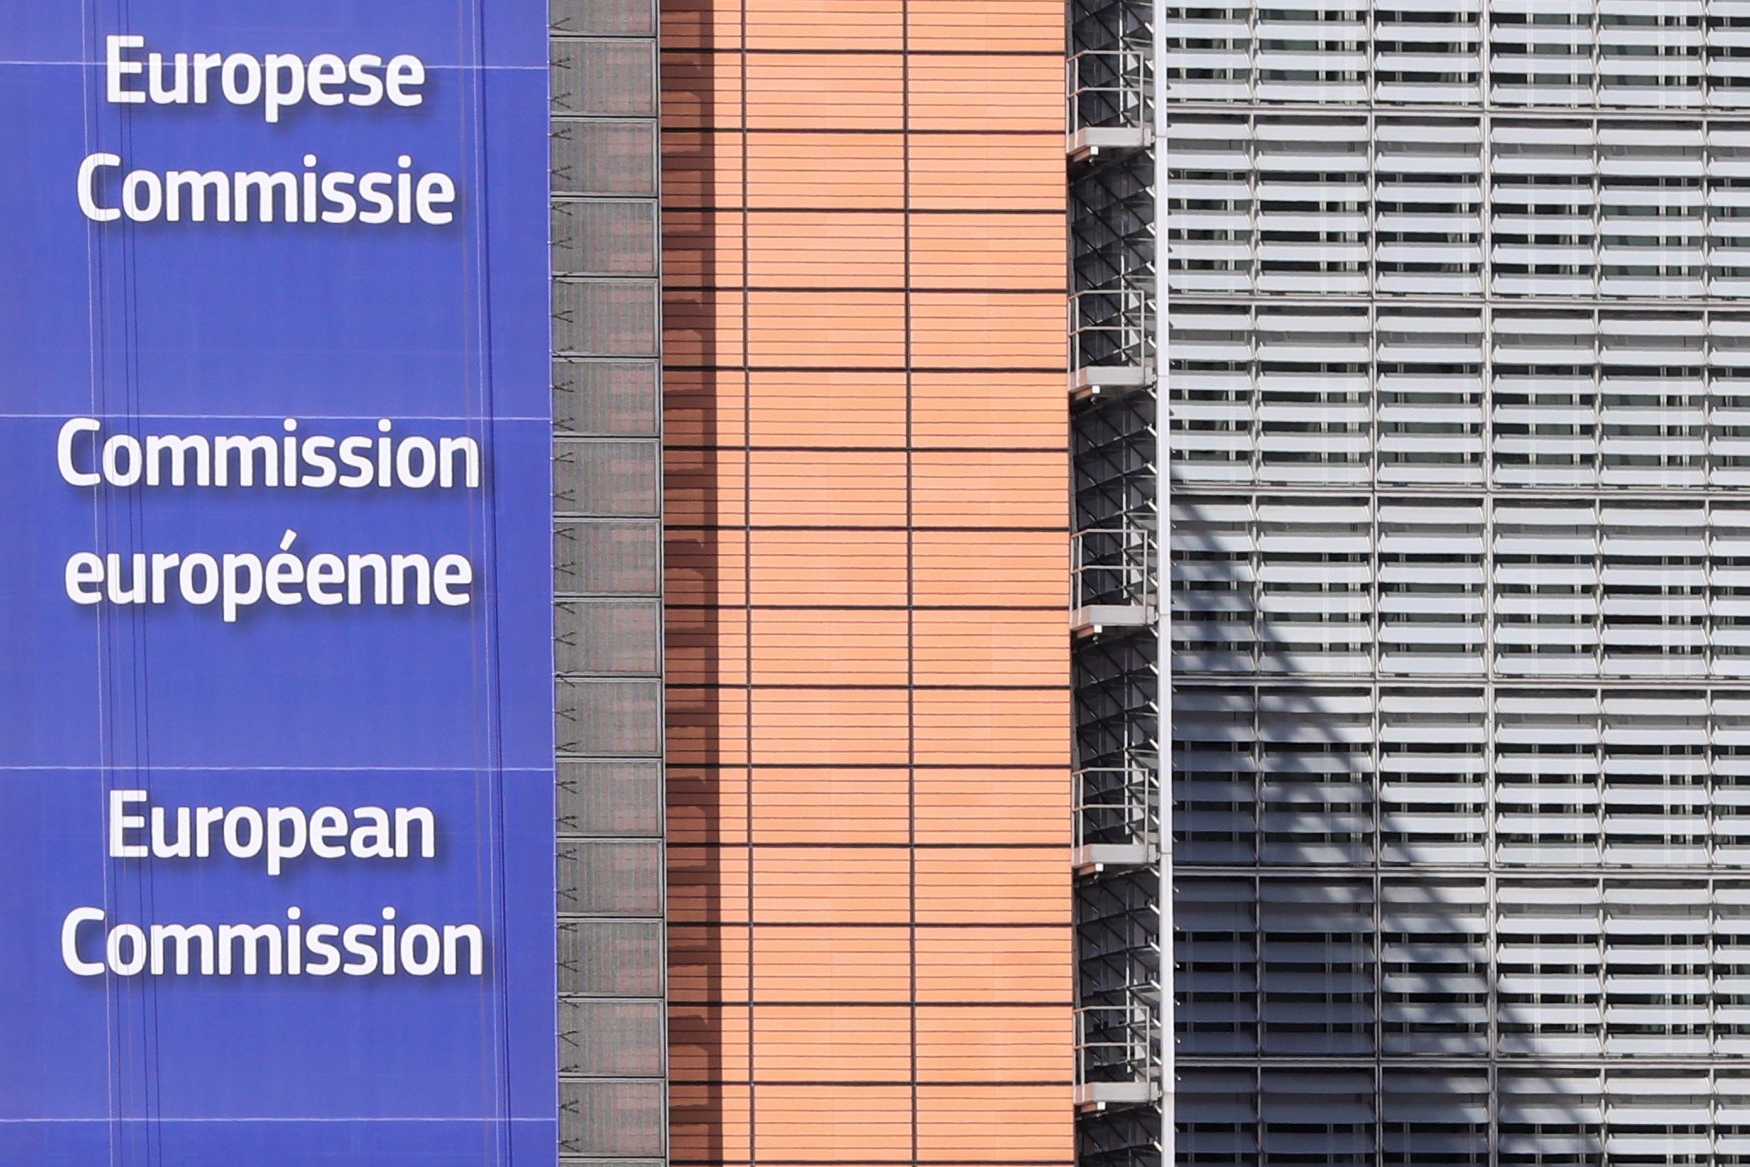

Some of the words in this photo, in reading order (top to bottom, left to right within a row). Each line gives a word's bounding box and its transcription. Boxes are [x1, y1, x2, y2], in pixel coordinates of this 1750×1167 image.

[106, 34, 426, 123] Europese
[76, 152, 456, 225] Commissie
[57, 416, 480, 488] Commission
[65, 529, 473, 623] européenne
[109, 789, 436, 877] European
[61, 906, 484, 976] Commission
